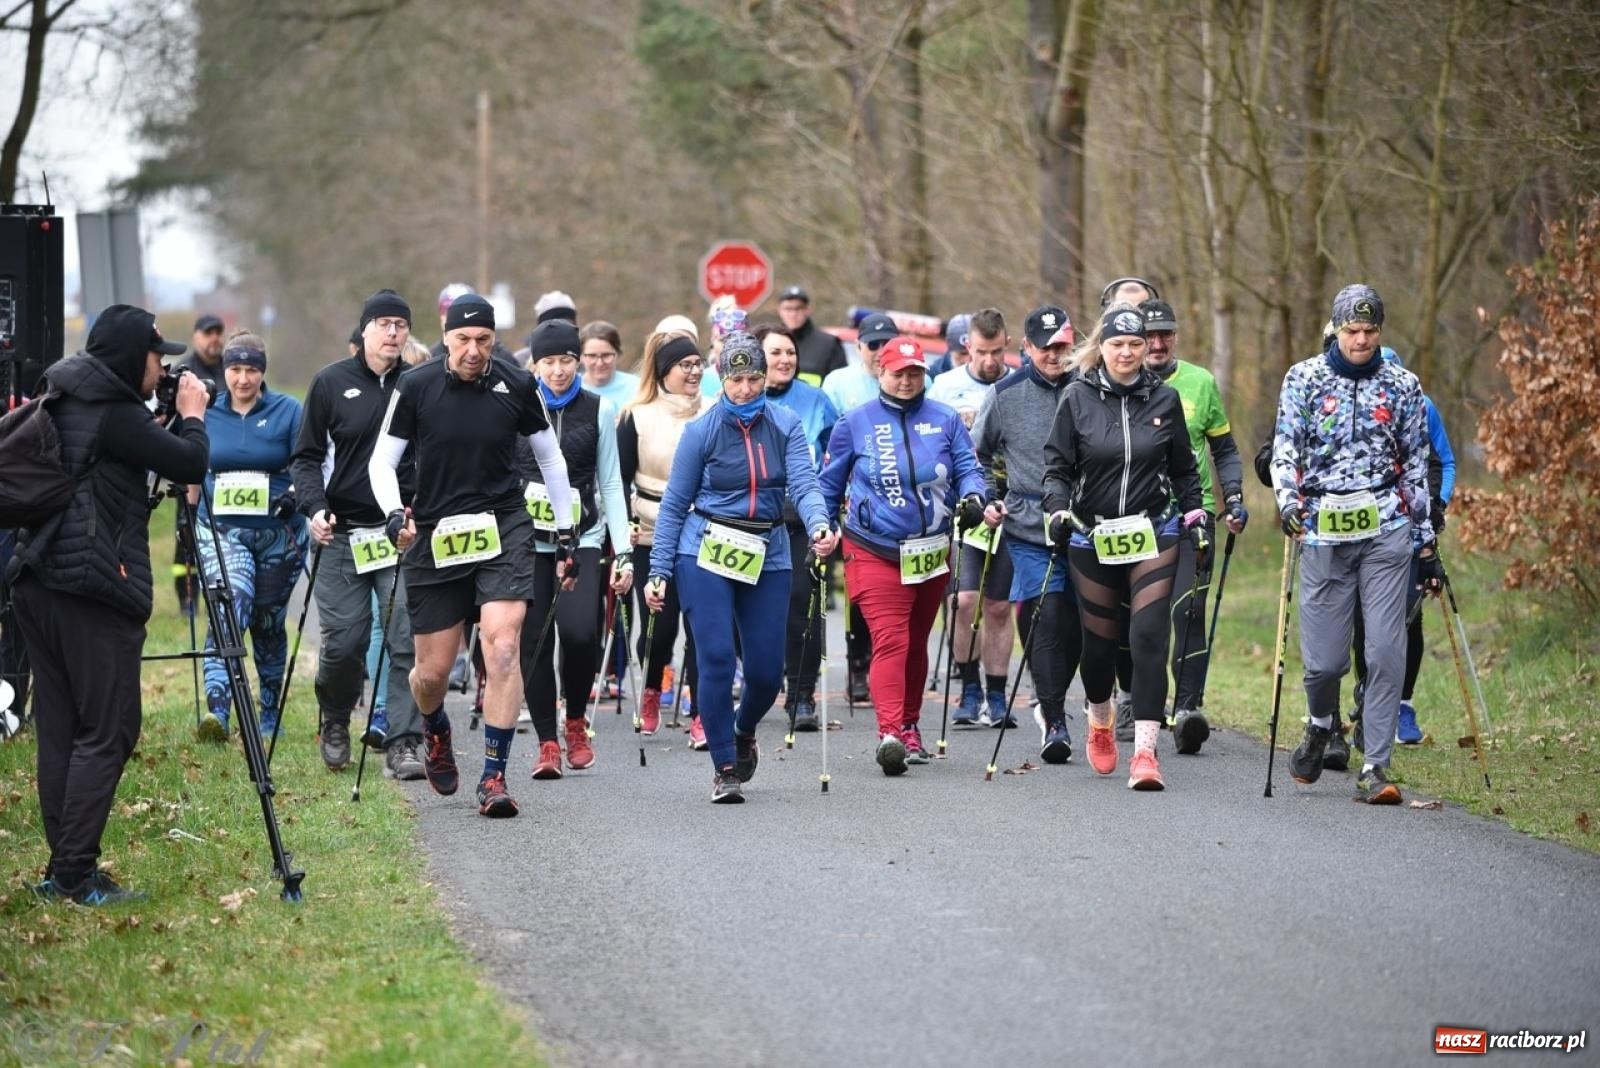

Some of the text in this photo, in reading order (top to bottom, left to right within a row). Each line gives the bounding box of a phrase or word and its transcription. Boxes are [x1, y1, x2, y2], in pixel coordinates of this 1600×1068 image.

[707, 264, 768, 290] STOP
[874, 423, 906, 507] RUNNERS
[223, 488, 260, 507] 164
[531, 501, 556, 521] 15
[1327, 508, 1371, 532] 158
[362, 539, 398, 563] 15
[443, 528, 489, 557] 175
[1103, 532, 1146, 556] 159
[709, 543, 756, 571] 167
[910, 549, 943, 575] 181
